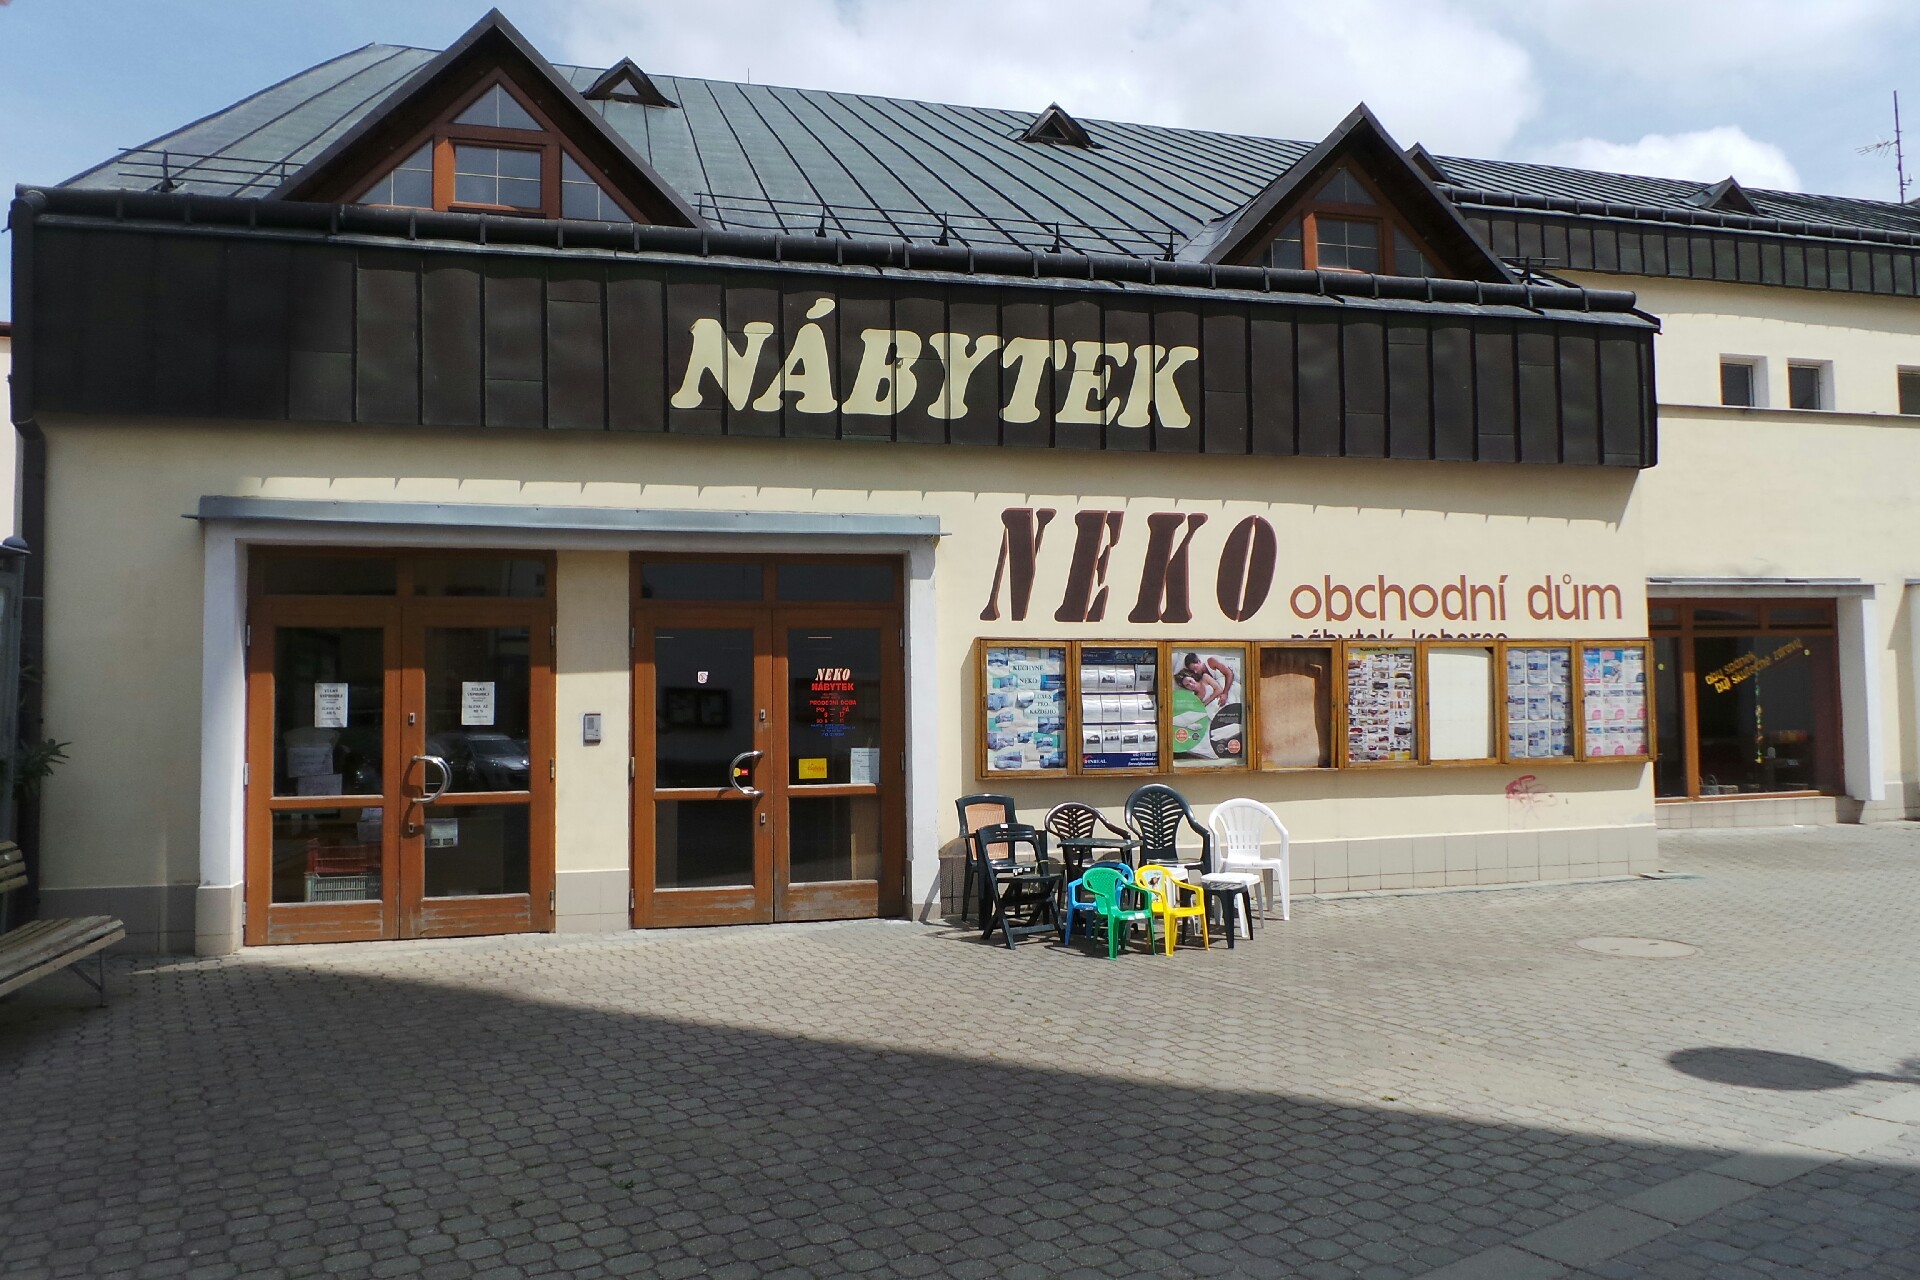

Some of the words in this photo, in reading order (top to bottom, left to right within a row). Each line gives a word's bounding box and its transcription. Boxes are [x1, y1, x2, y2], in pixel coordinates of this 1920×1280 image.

[670, 298, 1199, 428] NÁBYTEK
[979, 507, 1278, 624] NEKO
[1290, 574, 1508, 622] obchodní
[1527, 574, 1622, 621] dům
[811, 681, 854, 691] NÁBYTEK
[815, 668, 850, 681] NEKO
